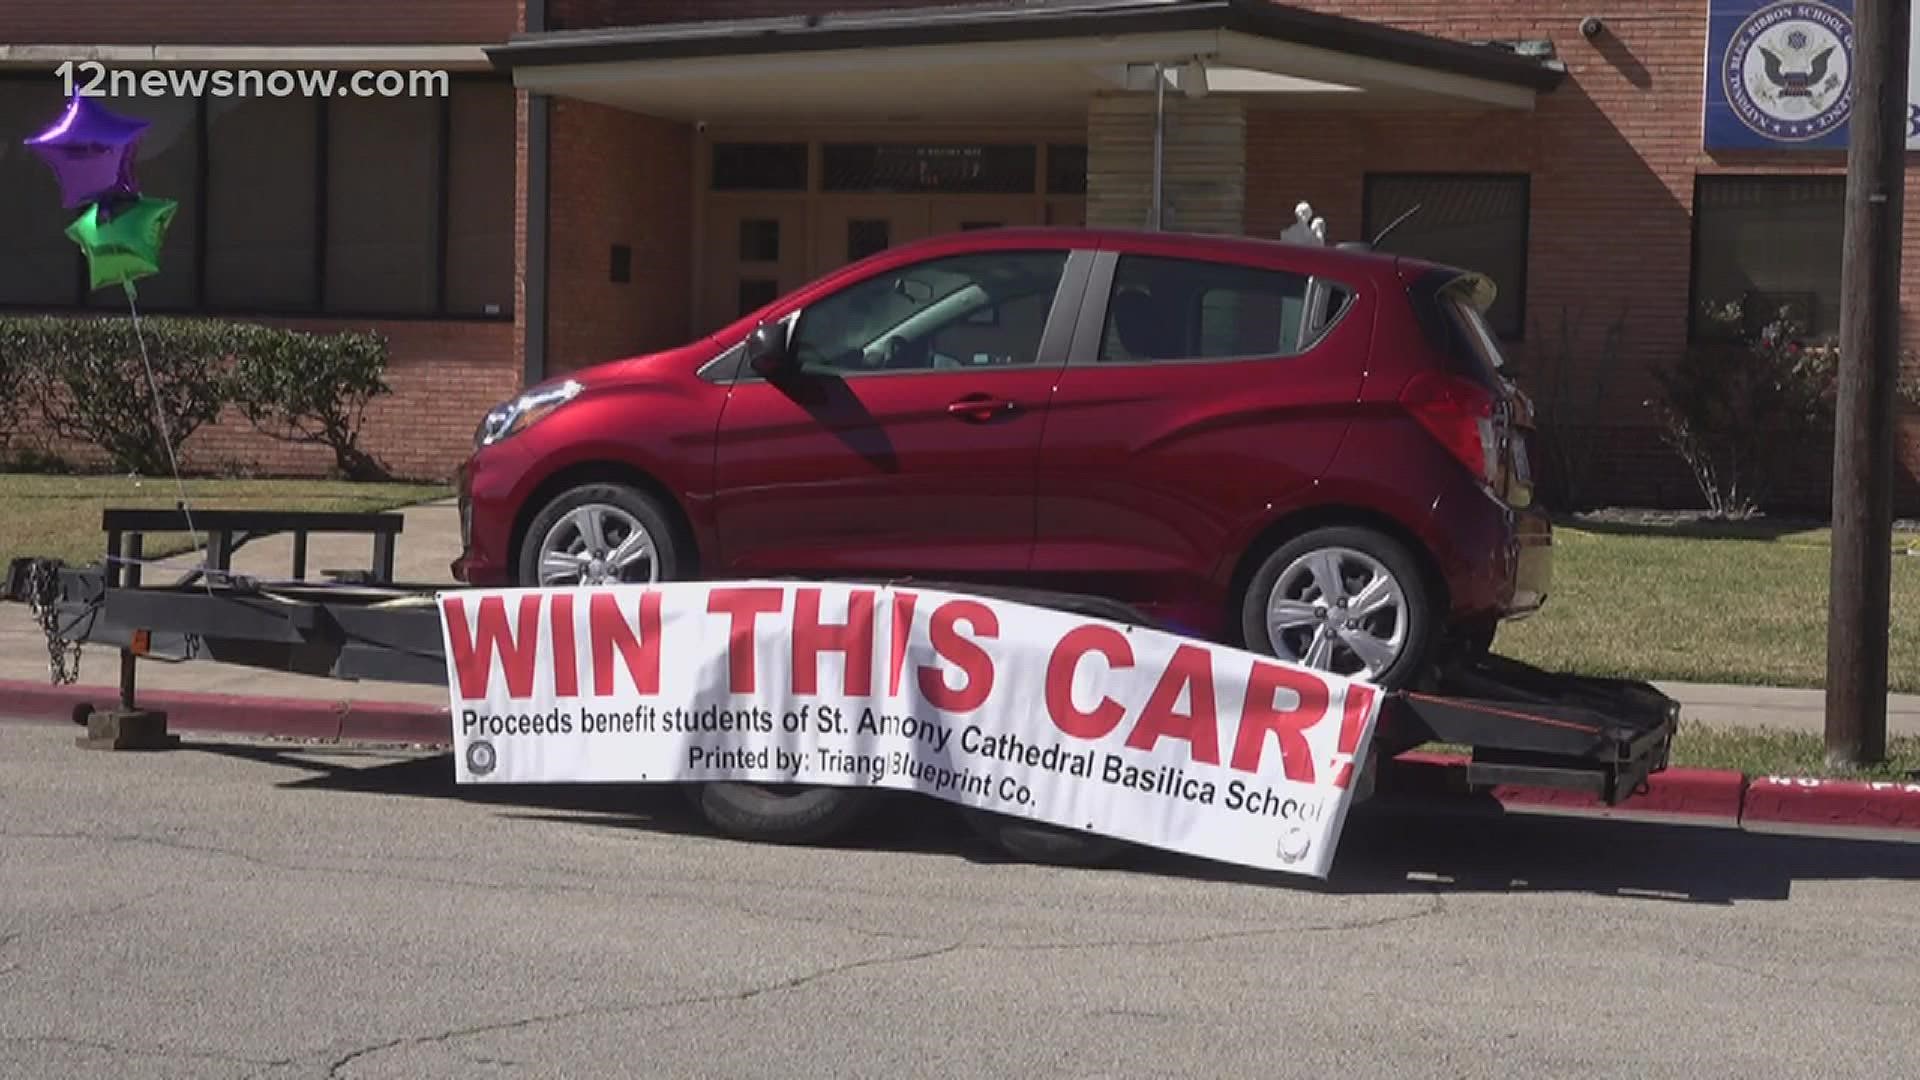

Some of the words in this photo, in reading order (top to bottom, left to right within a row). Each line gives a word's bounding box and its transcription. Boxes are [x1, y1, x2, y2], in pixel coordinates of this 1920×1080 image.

[1797, 6, 1844, 33] SCHOOL
[443, 591, 662, 700] WIN
[706, 588, 999, 712] THIS
[1045, 624, 1375, 791] CAR!
[462, 708, 572, 736] Proceeds
[582, 705, 656, 733] benefit
[663, 704, 773, 732] students
[783, 705, 811, 732] of
[817, 707, 848, 734] St.
[961, 724, 1093, 778] Cathedral
[1101, 754, 1216, 805] Basilica
[688, 745, 768, 770] Printed
[776, 746, 810, 777] by:
[892, 751, 991, 798] Blueprint
[999, 777, 1036, 806] Co.
